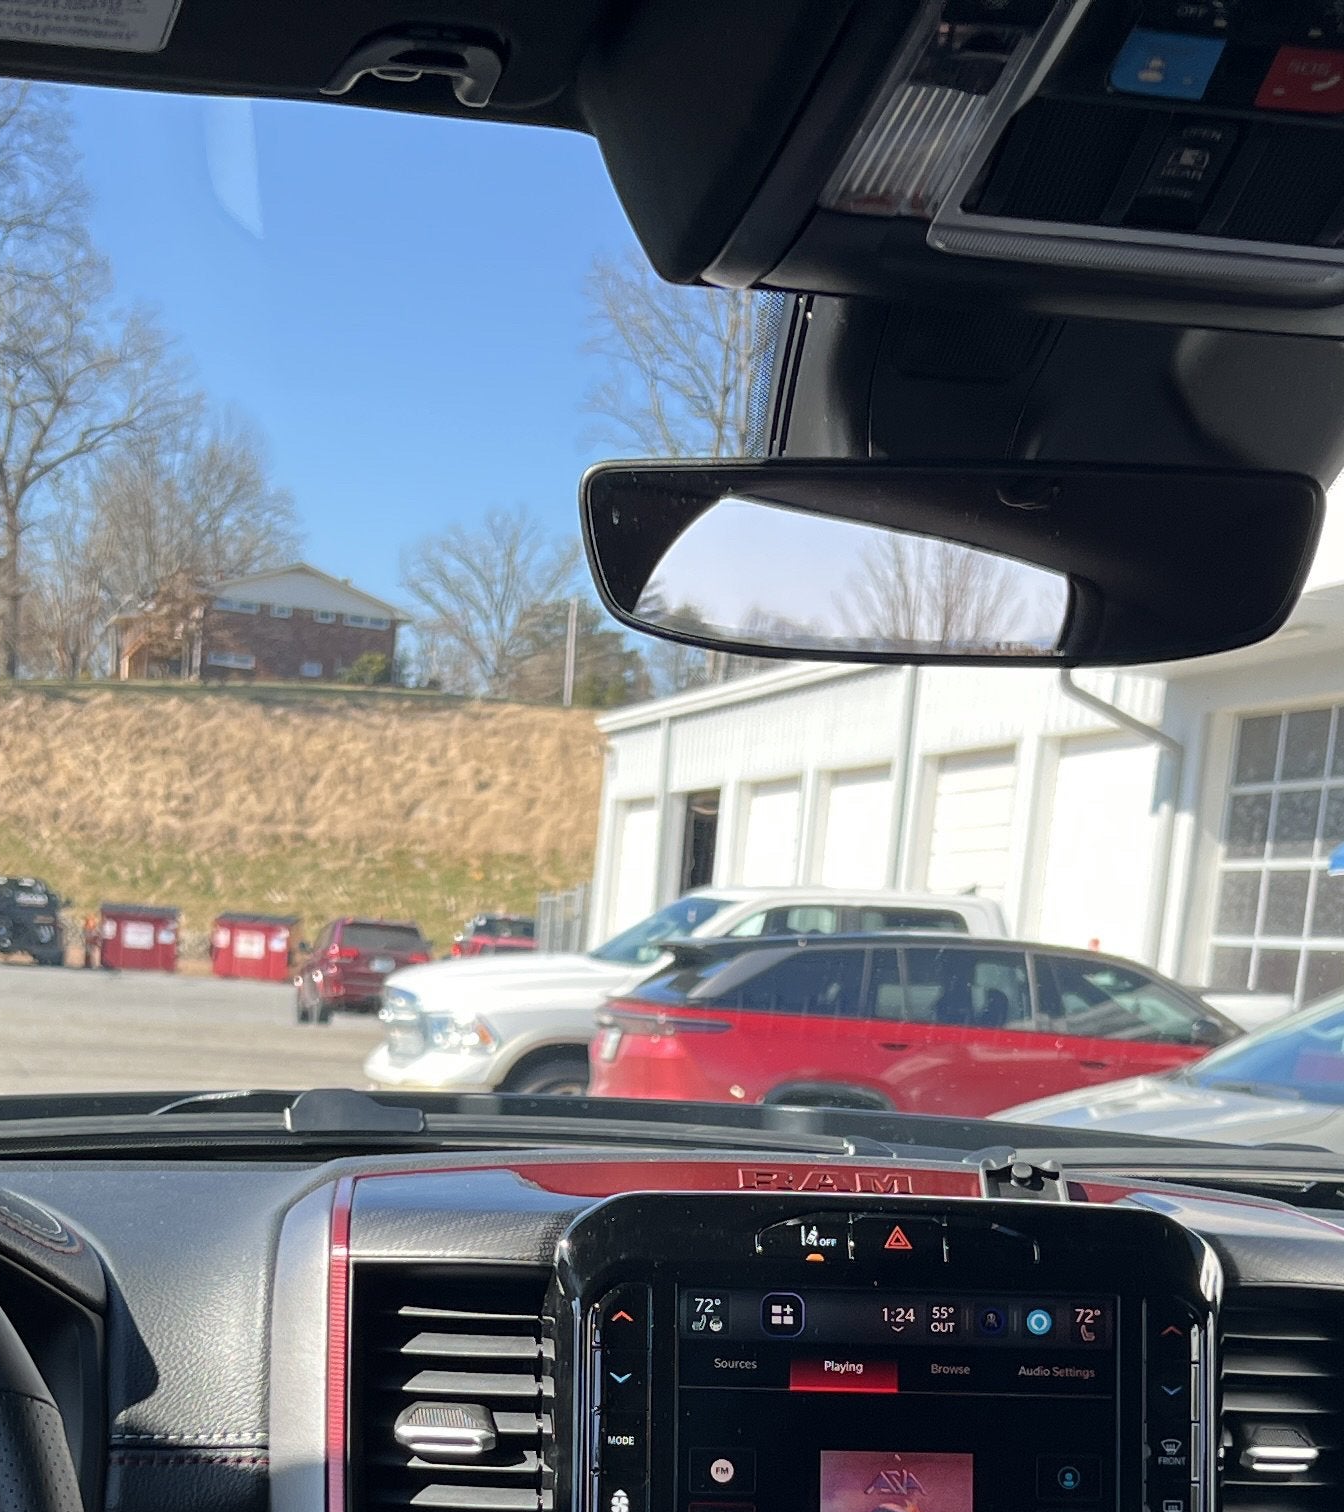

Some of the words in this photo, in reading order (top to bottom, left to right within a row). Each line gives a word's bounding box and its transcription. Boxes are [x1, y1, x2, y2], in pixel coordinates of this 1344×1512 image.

[737, 1167, 914, 1196] RAM
[818, 1238, 838, 1248] OFF
[693, 1297, 722, 1314] 72°
[881, 1307, 917, 1324] 1:24
[931, 1306, 956, 1320] 55°
[1074, 1308, 1102, 1324] 72°
[929, 1321, 956, 1334] OUT
[713, 1357, 758, 1370] Sources
[823, 1360, 865, 1375] Playing
[929, 1362, 972, 1376] Browse
[1017, 1365, 1051, 1378] Audio
[1051, 1366, 1097, 1380] Settings
[607, 1434, 636, 1447] MODE
[1157, 1455, 1187, 1466] FRONT
[714, 1466, 730, 1476] FM
